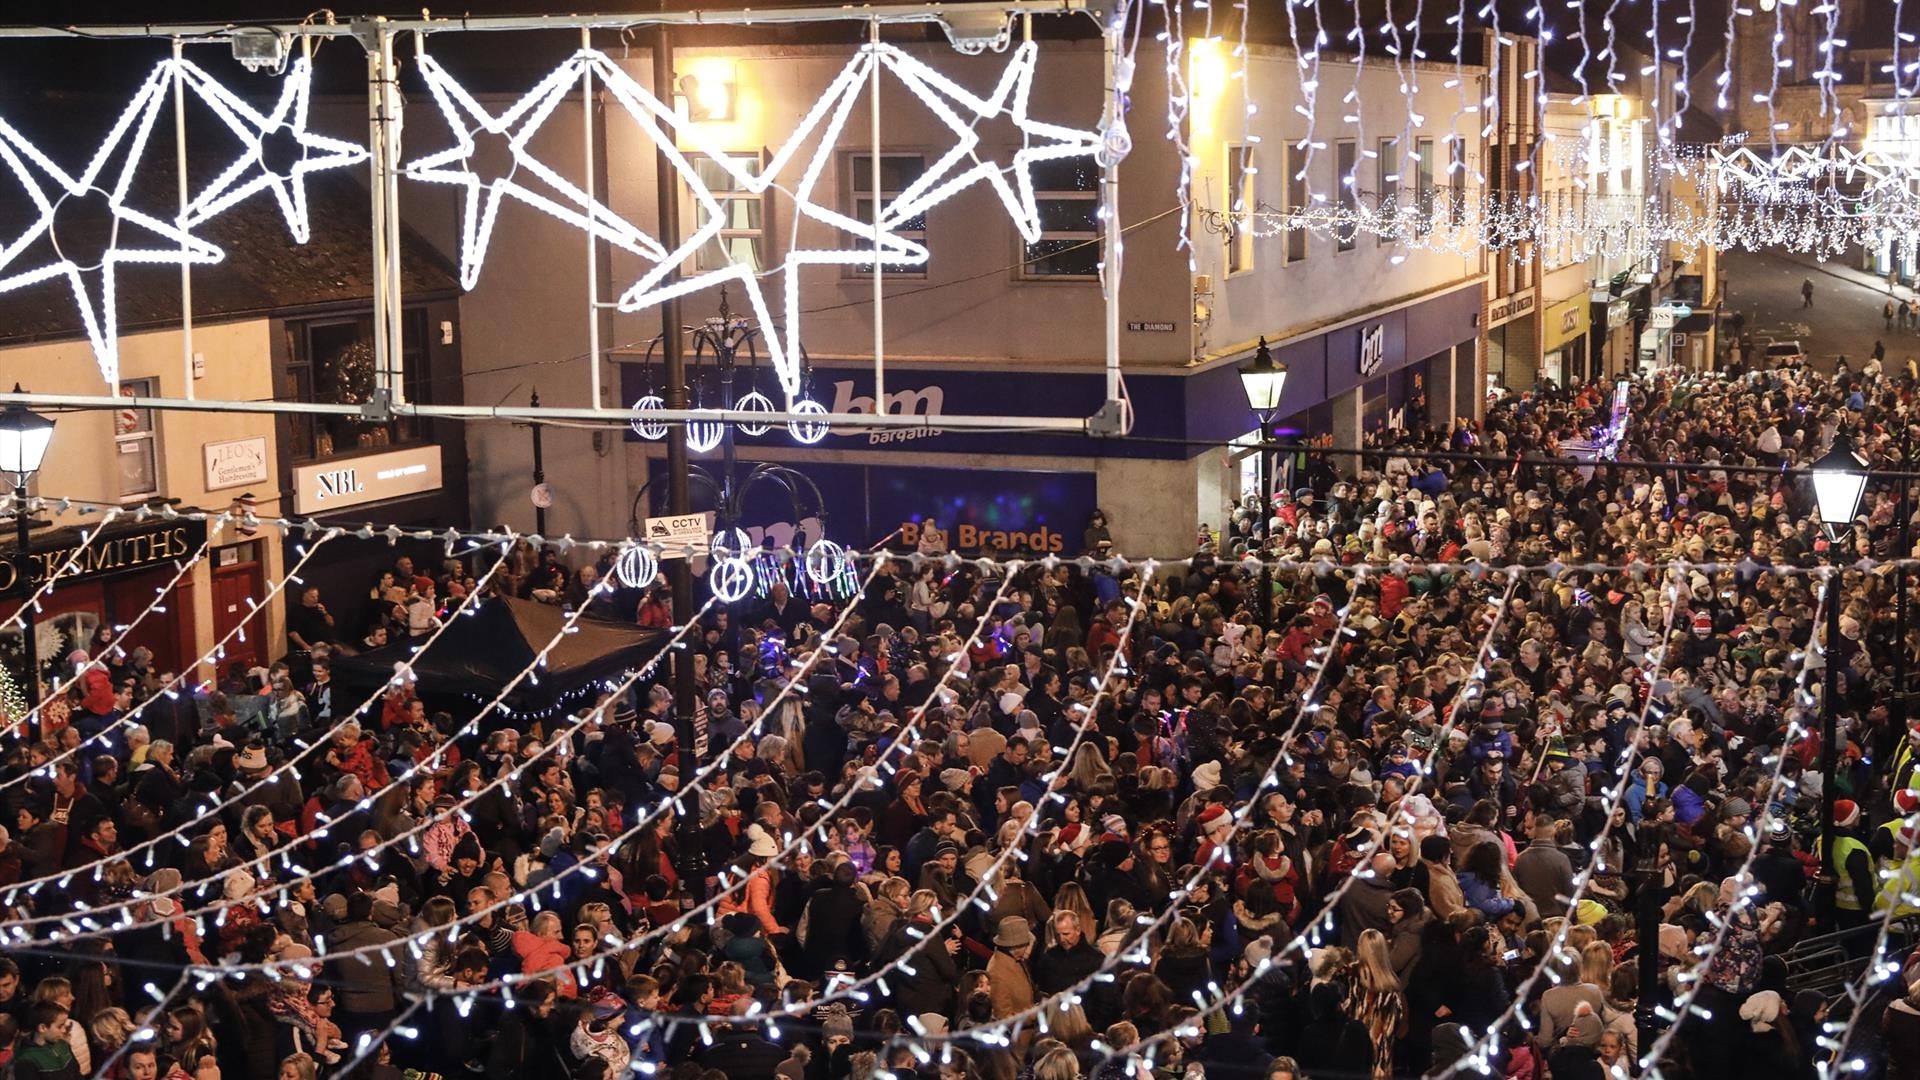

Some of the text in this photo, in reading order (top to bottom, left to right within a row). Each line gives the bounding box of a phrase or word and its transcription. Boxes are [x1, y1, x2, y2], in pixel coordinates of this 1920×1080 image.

[1130, 323, 1173, 331] THE DIAMOND
[1361, 324, 1383, 374] bm
[832, 379, 944, 437] bm
[217, 444, 255, 463] LEO'S
[318, 467, 364, 499] NBL
[672, 518, 701, 528] CCTV
[959, 524, 1064, 551] Brands
